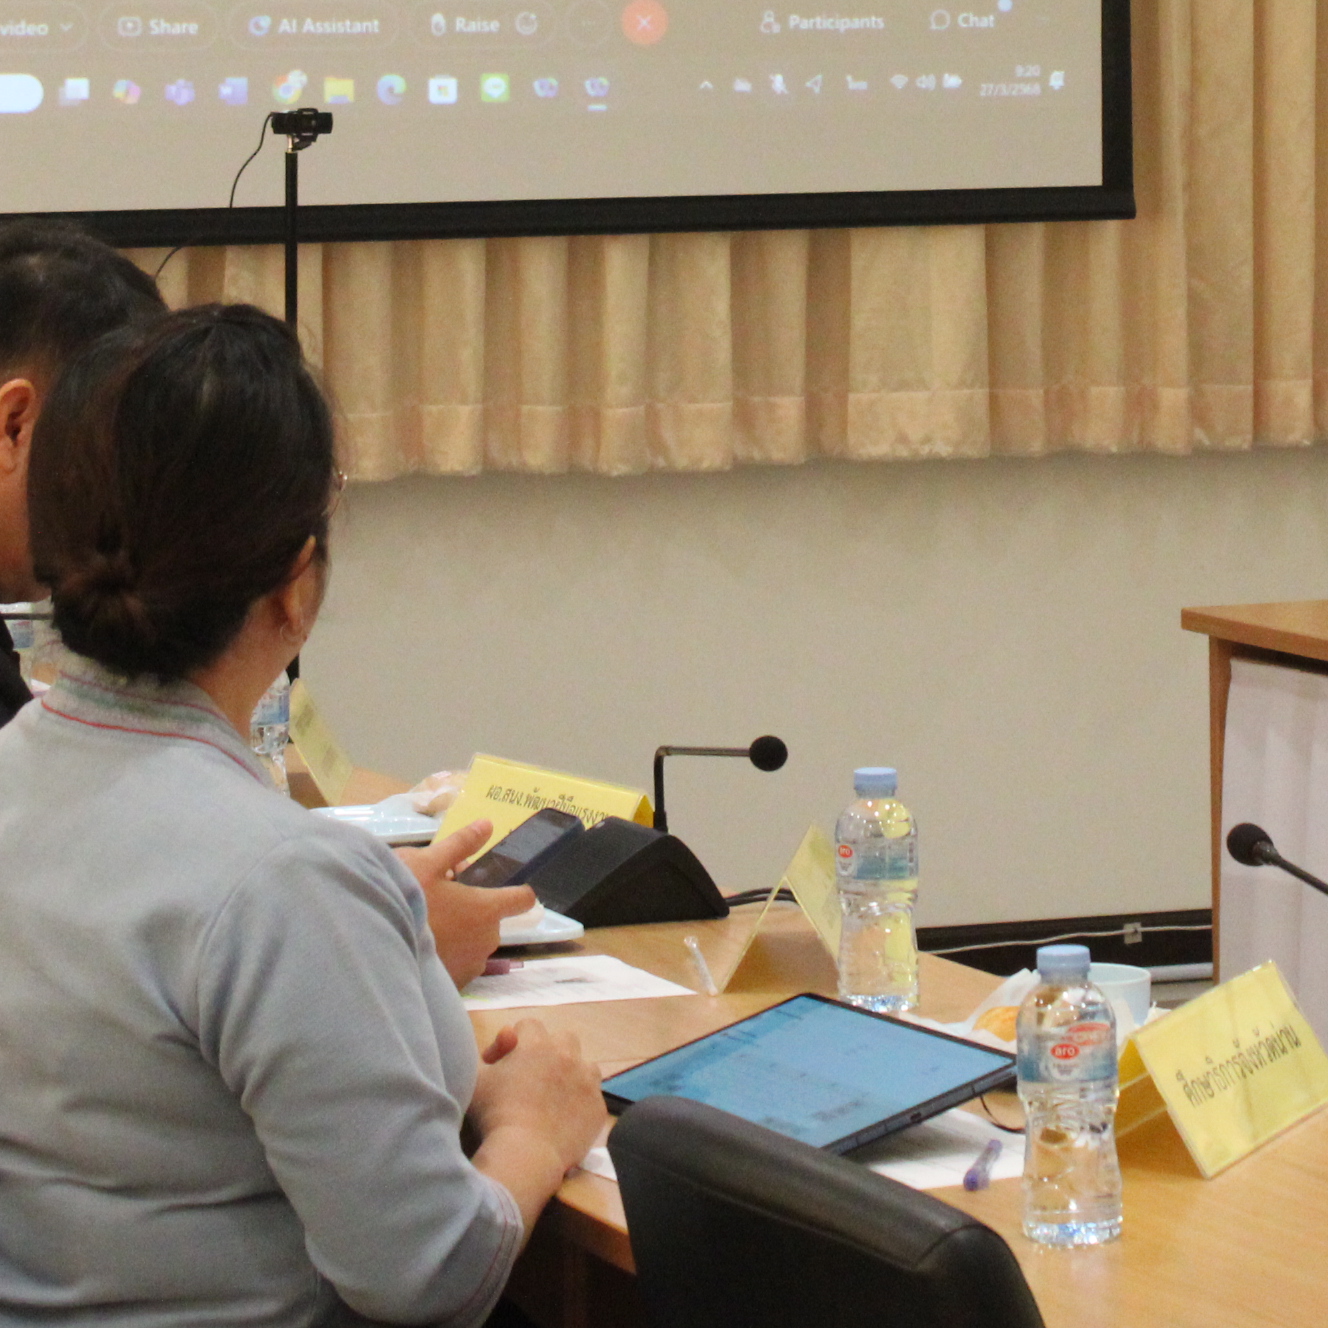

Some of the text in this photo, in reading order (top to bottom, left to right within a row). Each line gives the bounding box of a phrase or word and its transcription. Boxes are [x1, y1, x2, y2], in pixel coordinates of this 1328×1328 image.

[149, 18, 199, 35] Share
[278, 18, 380, 34] AI Assistant
[455, 17, 501, 33] Raise
[788, 14, 885, 33] Participants
[958, 12, 995, 28] Chat
[1054, 1046, 1076, 1057] aro
[1175, 1021, 1302, 1108] ศึกษาธิการจังหวัดน่าน
